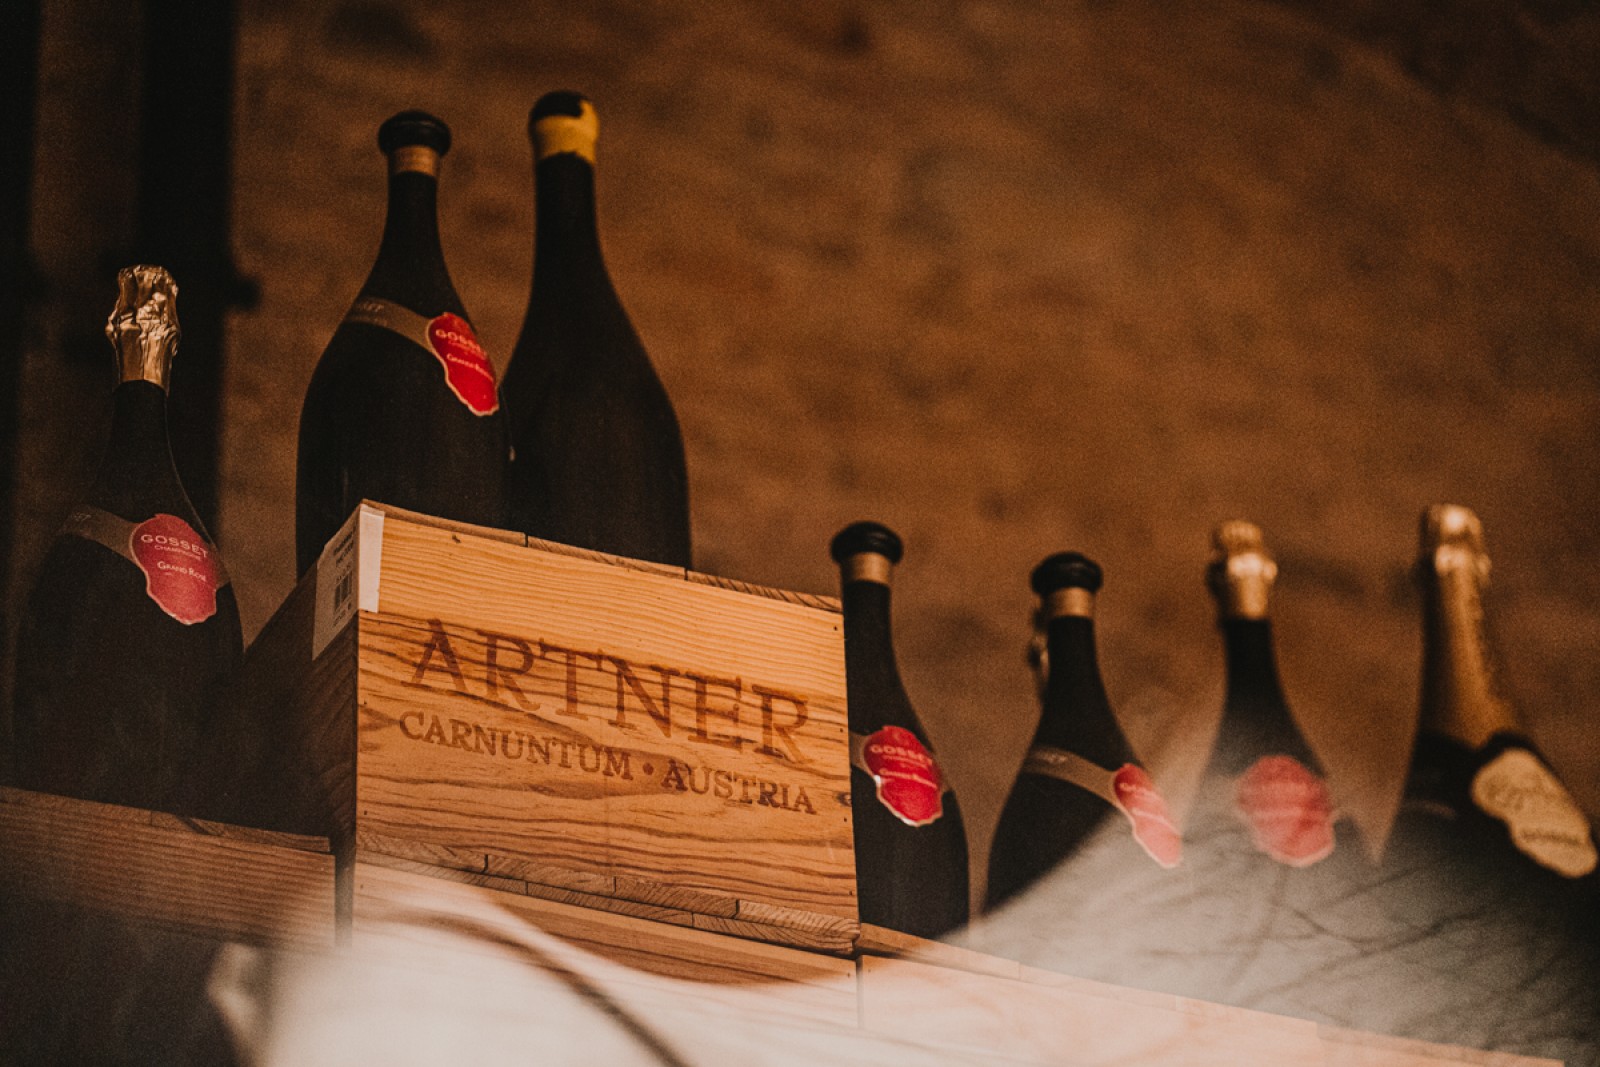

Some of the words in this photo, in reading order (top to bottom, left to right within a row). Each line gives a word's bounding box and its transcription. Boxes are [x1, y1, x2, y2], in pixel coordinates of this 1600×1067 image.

[140, 534, 208, 558] GOSSET
[407, 617, 814, 764] ARTNER
[399, 711, 635, 781] CARNUNTUM
[661, 758, 818, 815] AUSTRIA
